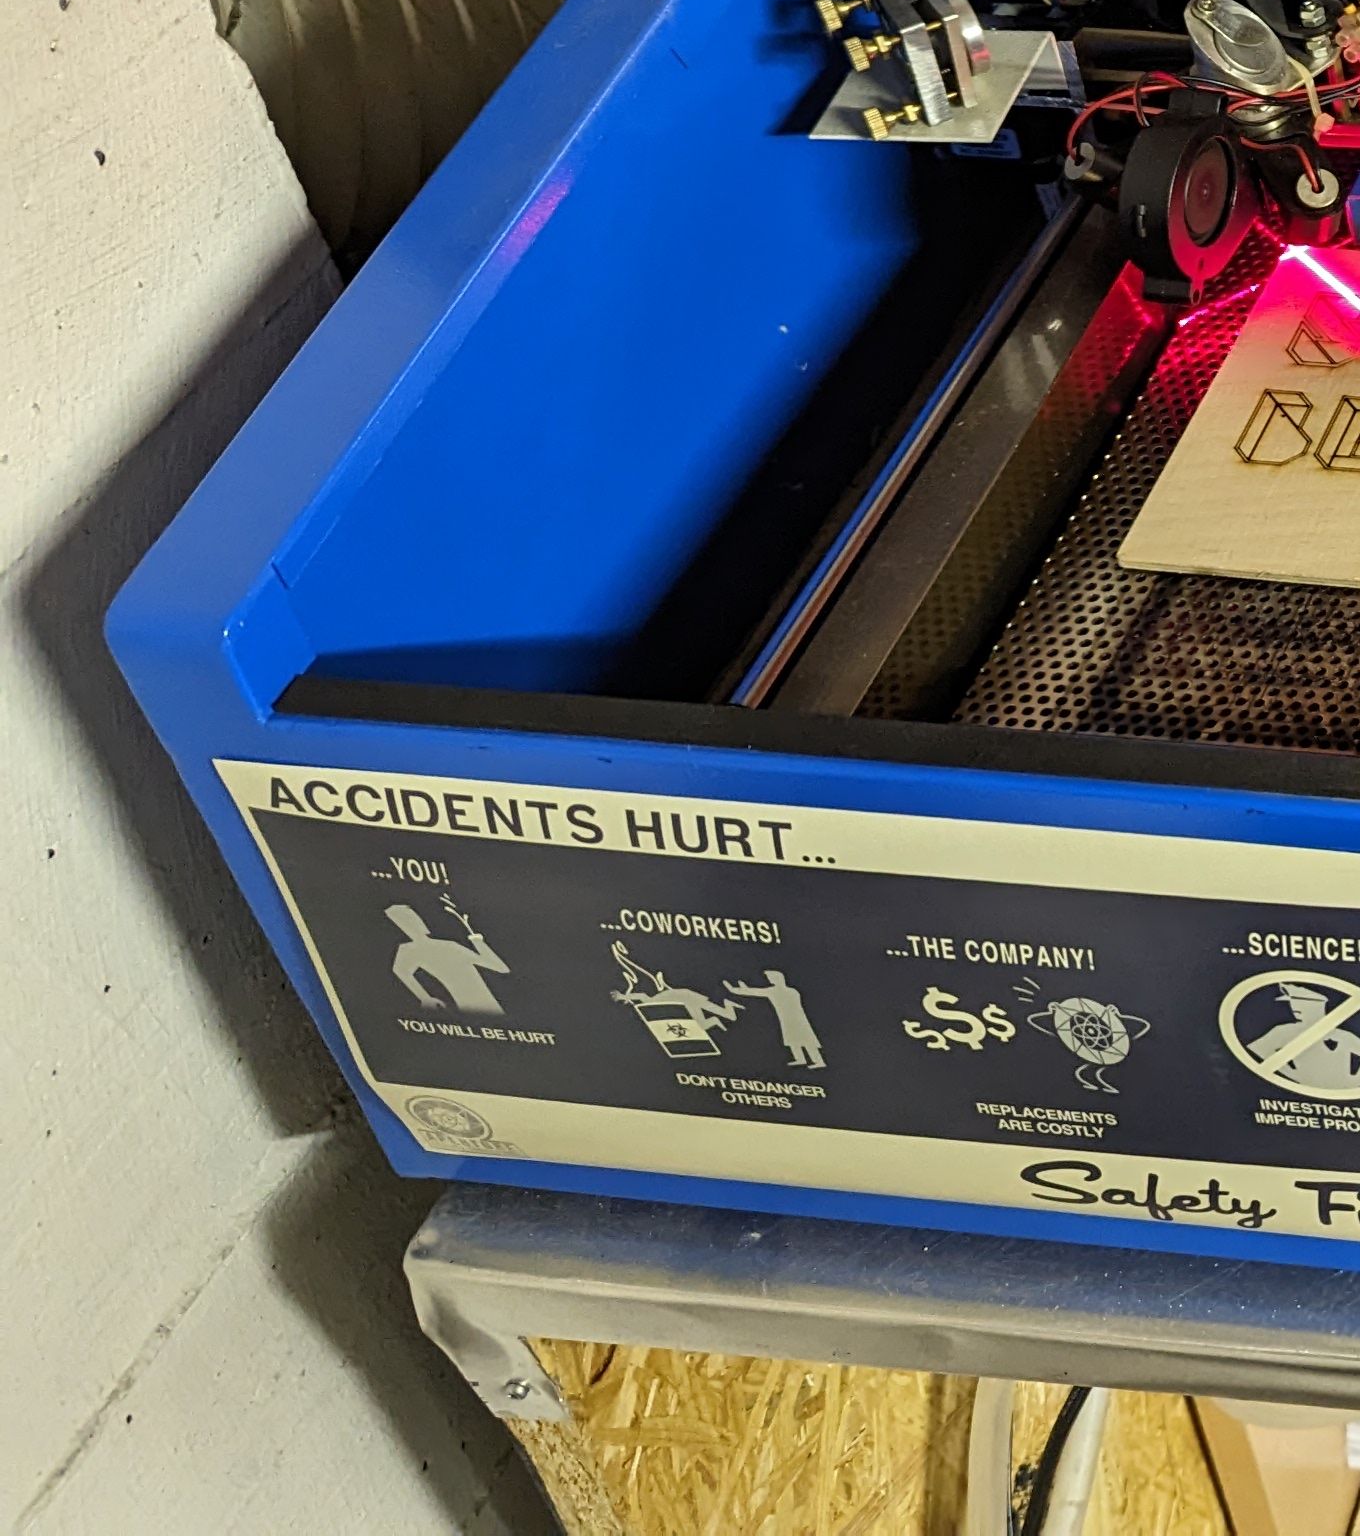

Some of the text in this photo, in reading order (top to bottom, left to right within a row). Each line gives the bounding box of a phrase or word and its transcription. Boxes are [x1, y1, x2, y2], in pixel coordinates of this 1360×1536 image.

[270, 776, 604, 844] ACCIDENTS
[964, 939, 1096, 971] COMPANY!
[397, 1018, 556, 1046] YOU WILL BE HURT
[675, 1072, 827, 1100] DON'T ENDANGER
[722, 1091, 792, 1110] OTHERS
[976, 1102, 1118, 1126] REPLACEMENTS
[998, 1118, 1105, 1139] ARE COSTLY
[1254, 1112, 1322, 1129] IMPEDE
[1019, 1160, 1278, 1230] Safety
